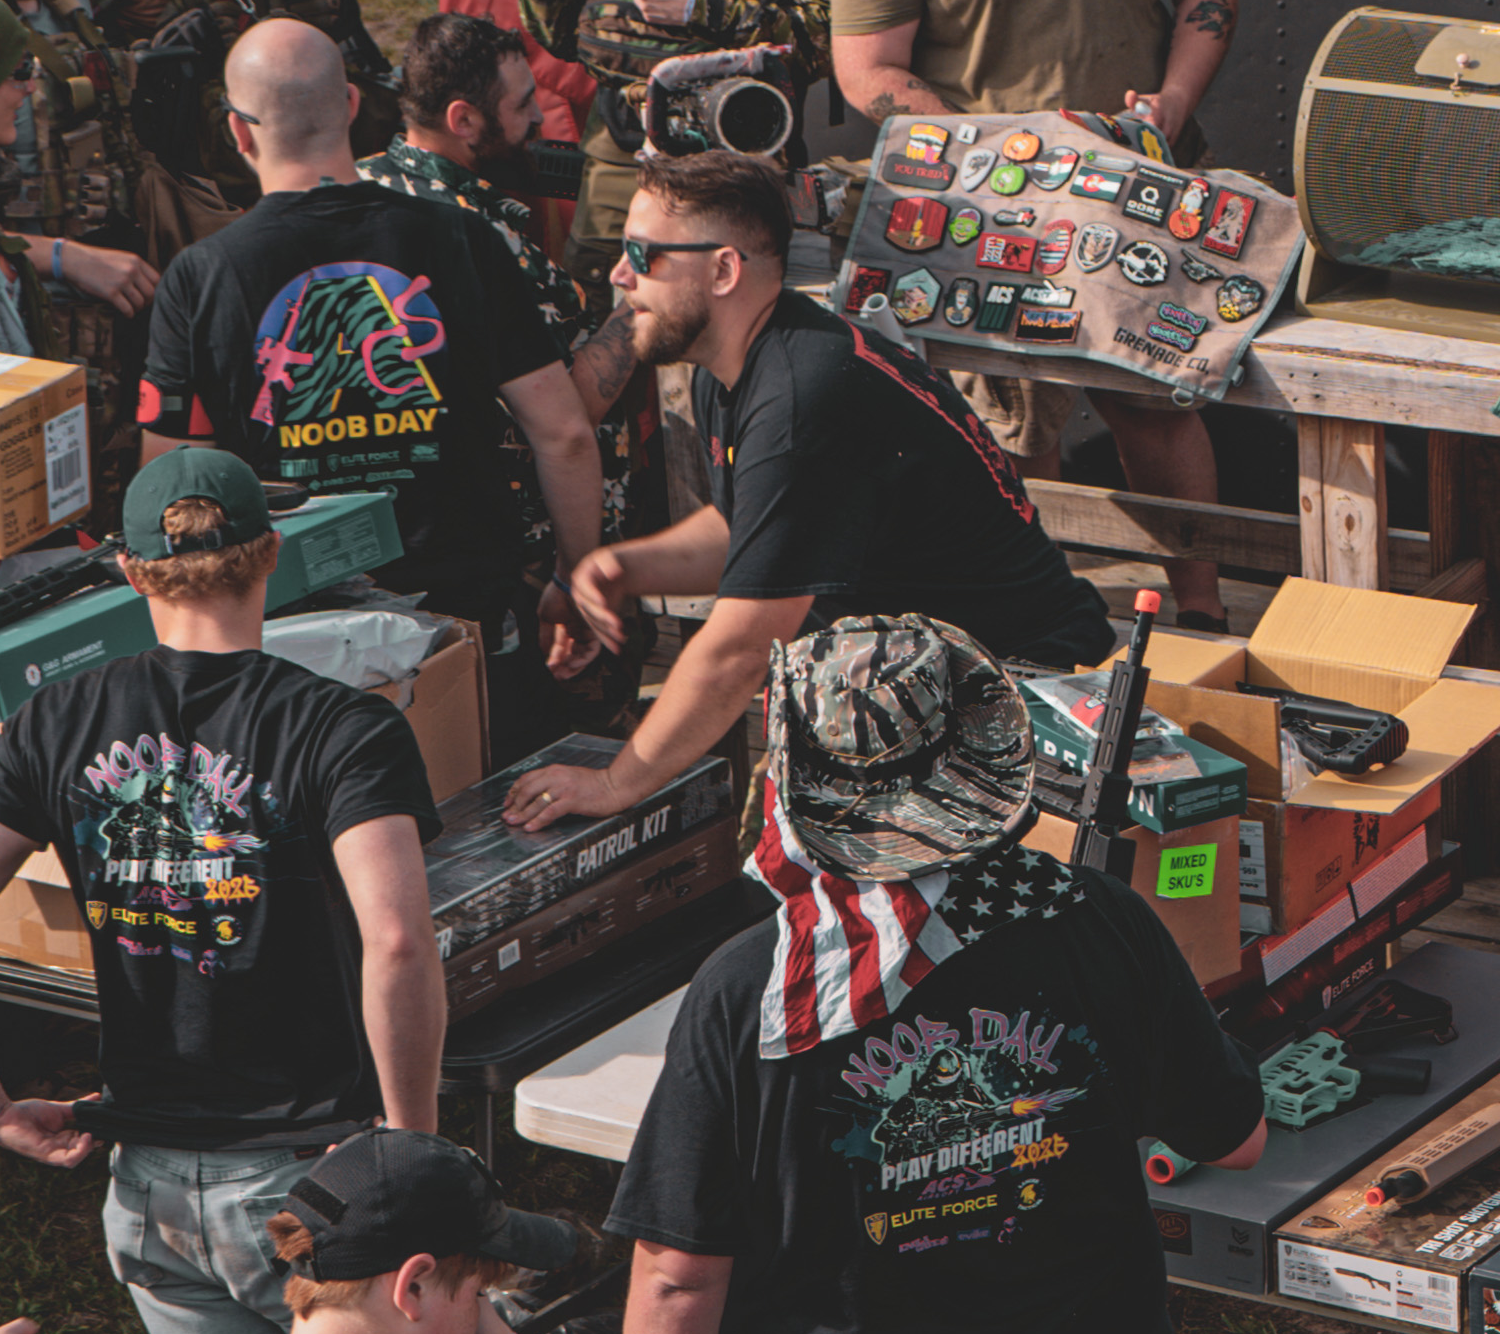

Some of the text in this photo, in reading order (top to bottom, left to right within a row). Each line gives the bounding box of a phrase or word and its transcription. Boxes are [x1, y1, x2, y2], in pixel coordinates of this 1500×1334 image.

[894, 163, 914, 174] YOU
[987, 285, 1015, 304] ACS
[1113, 327, 1185, 368] GRENADE
[279, 407, 439, 448] NOOB DAY
[186, 741, 253, 818] DAY
[576, 805, 671, 879] PATROL KIT
[1170, 853, 1207, 871] MIXED
[204, 875, 260, 905] 2025
[1168, 873, 1205, 891] SKU'S
[112, 907, 197, 935] ELITE FORCE
[1332, 958, 1375, 1000] ELITE FORCE
[841, 1007, 1064, 1098] NOOB DAY
[881, 1118, 1046, 1191] PLAY DIFFERENT
[1010, 1133, 1069, 1169] 2025
[921, 1173, 967, 1196] ACS
[890, 1194, 998, 1228] ELITE FORCE
[1416, 1237, 1436, 1255] TRI
[1433, 1213, 1469, 1245] SHOT
